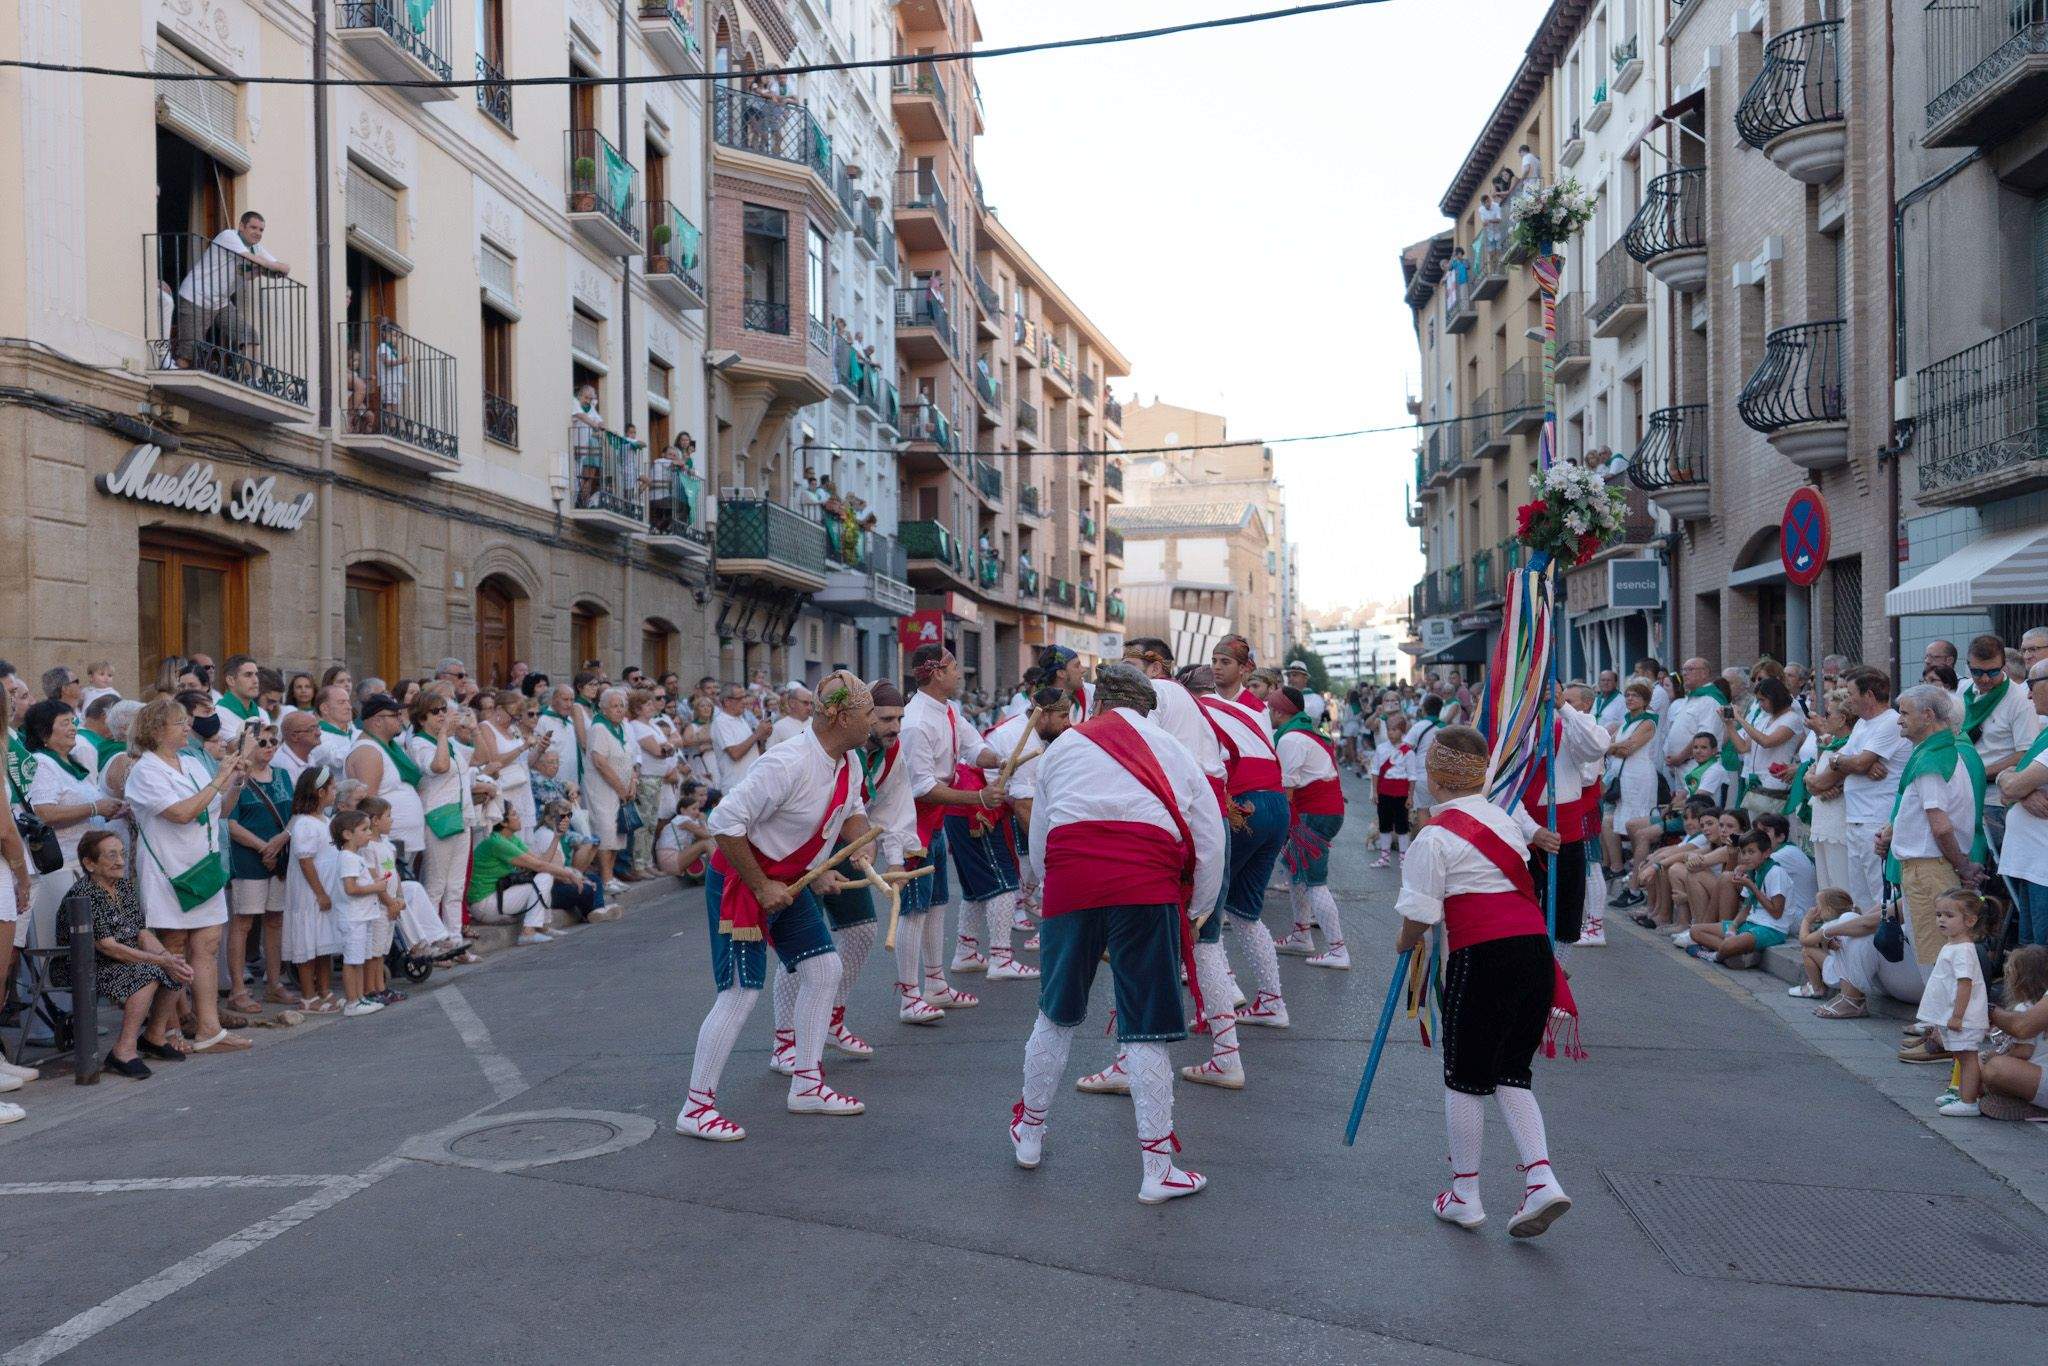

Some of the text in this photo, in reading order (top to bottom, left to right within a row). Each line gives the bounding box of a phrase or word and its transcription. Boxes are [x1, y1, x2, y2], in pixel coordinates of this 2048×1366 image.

[105, 443, 314, 530] Muebles Arnal
[1615, 579, 1657, 590] esencia
